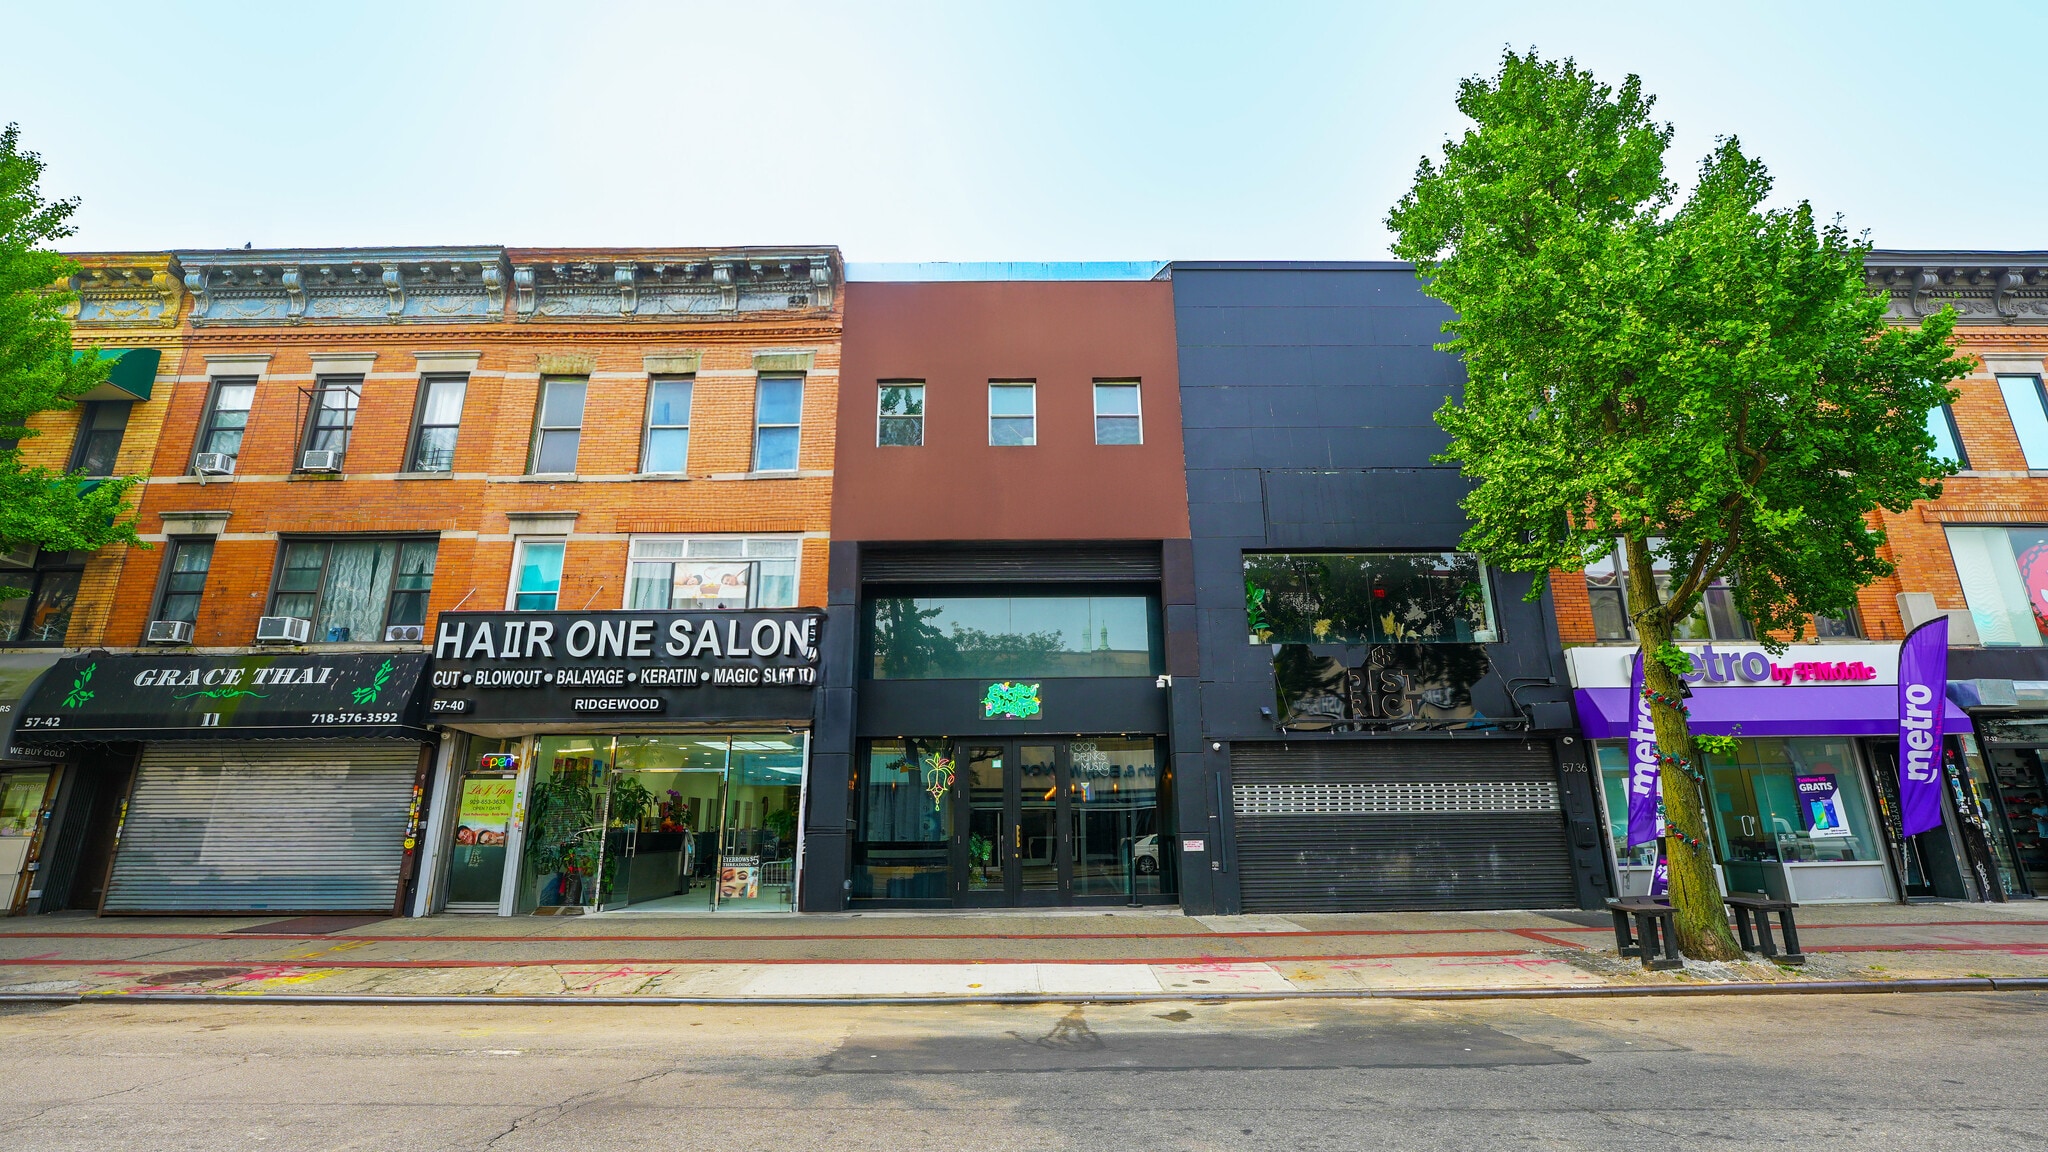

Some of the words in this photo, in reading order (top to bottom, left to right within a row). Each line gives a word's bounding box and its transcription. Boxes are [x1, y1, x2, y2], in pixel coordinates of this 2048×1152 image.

[566, 620, 654, 657] ONE
[666, 619, 810, 657] SALON
[1624, 645, 1771, 683] etro
[1771, 663, 1793, 686] by
[133, 668, 245, 687] GRACE
[250, 667, 334, 685] THAI
[433, 671, 461, 686] CUT
[475, 670, 542, 685] BLOWOUT
[556, 670, 624, 684] BALAYAGE
[640, 669, 697, 684] KERATIN
[713, 668, 759, 683] MAGIC
[433, 701, 465, 711] 57-40
[574, 699, 659, 710] RIDGEWOOD
[25, 717, 60, 727] 57-42
[311, 713, 398, 724] 718-576-3592
[1901, 684, 1937, 784] metro
[10, 747, 23, 755] WE
[25, 748, 42, 756] BUY
[43, 749, 65, 758] GOLD
[1070, 743, 1096, 752] FOOD
[1074, 752, 1107, 761] DRINKS
[1081, 761, 1110, 775] MUSIC
[1799, 782, 1833, 792] GRATIS
[1889, 801, 1904, 840] MYRTLE
